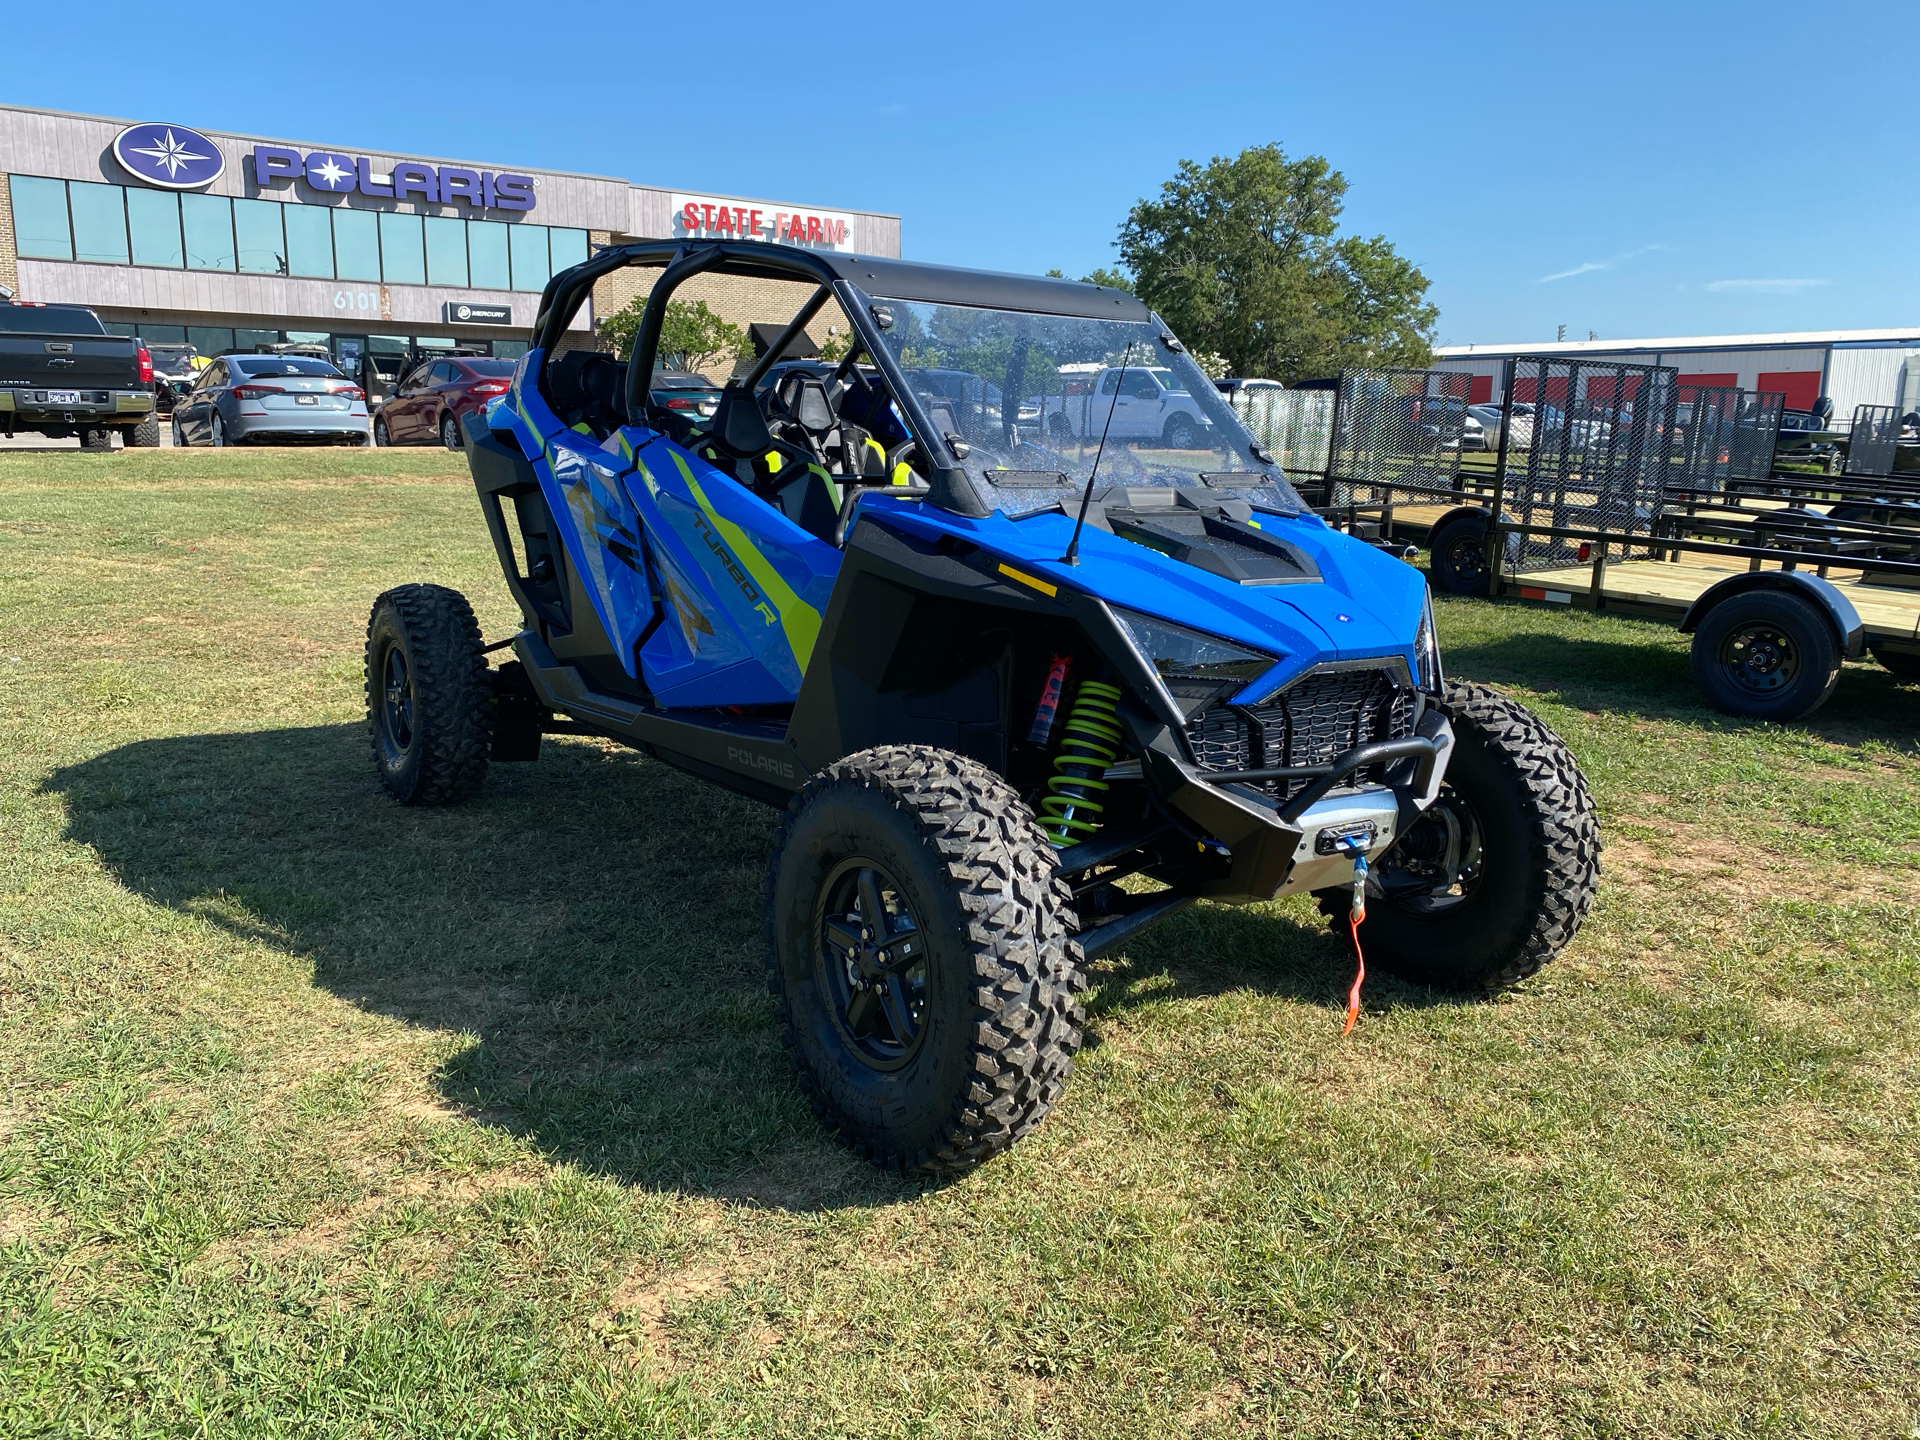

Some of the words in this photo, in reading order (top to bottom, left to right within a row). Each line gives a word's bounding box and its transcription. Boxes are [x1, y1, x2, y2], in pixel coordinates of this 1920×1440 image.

[254, 146, 537, 211] POLARIS
[683, 202, 763, 236] STATE
[776, 212, 845, 245] FARM
[333, 290, 378, 311] 6101
[471, 310, 506, 319] MERCURY
[693, 512, 760, 603] TURBO
[754, 601, 777, 627] R
[727, 746, 795, 779] POLARIS
